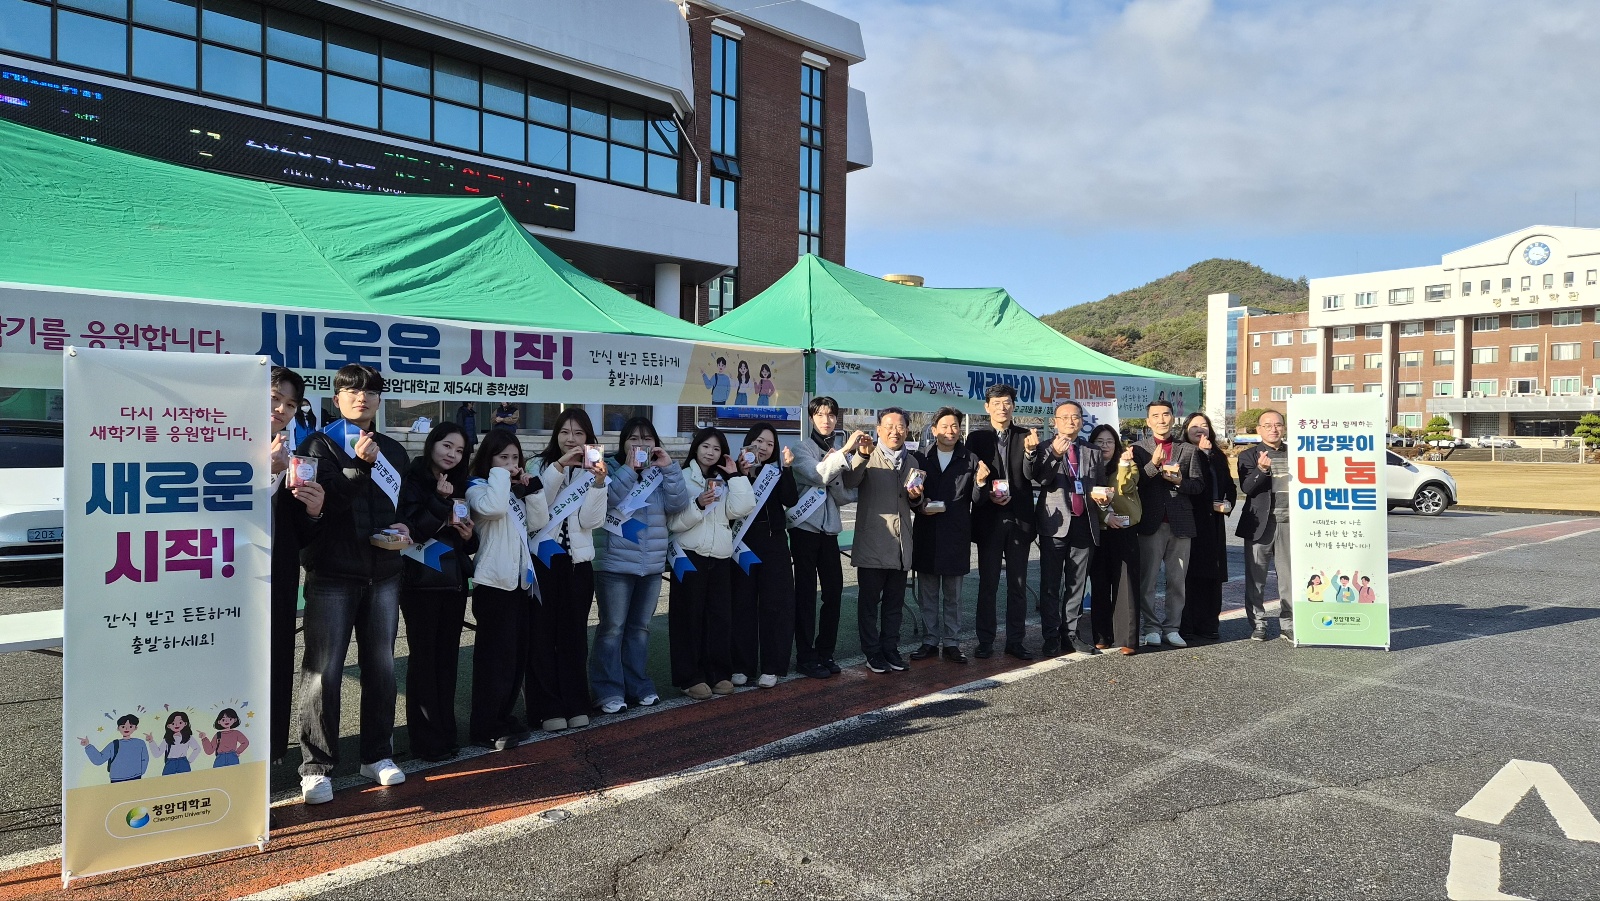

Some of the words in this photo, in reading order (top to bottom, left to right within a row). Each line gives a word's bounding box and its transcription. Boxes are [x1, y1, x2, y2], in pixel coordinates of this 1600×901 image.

[256, 311, 441, 374] 새로운
[461, 329, 574, 381] 시작!
[589, 350, 612, 365] 간식
[617, 350, 637, 366] 받고
[641, 352, 680, 368] 든든하게
[303, 375, 331, 391] 직원
[381, 377, 440, 394] 청암대학교
[443, 380, 483, 396] 제54대
[486, 383, 529, 397] 총학생회
[608, 370, 663, 387] 출발하세요!
[870, 368, 926, 394] 총장님과
[927, 379, 964, 397] 함께하는
[1039, 376, 1070, 403] 나눔
[1074, 378, 1116, 400] 이벤트
[120, 407, 153, 422] 다시
[162, 407, 228, 424] 시작하는
[1297, 418, 1338, 429] 총장님과
[1342, 420, 1373, 428] 함께하는
[90, 425, 160, 443] 새학기를
[167, 426, 253, 443] 응원합니다.
[1297, 434, 1374, 452] 개강맞이
[372, 460, 400, 493] 암대학교
[85, 461, 254, 516] 새로운
[1298, 487, 1377, 511] 이벤트
[1309, 530, 1322, 538] 나를
[1325, 530, 1338, 538] 위한
[1341, 530, 1348, 538] 한
[105, 527, 235, 585] 시작!
[1315, 541, 1333, 550] 학기를
[103, 611, 138, 629] 간식
[145, 609, 175, 627] 받고
[182, 606, 242, 622] 든든하게
[131, 632, 216, 655] 출발하세요!
[151, 796, 212, 817] 청암대학교
